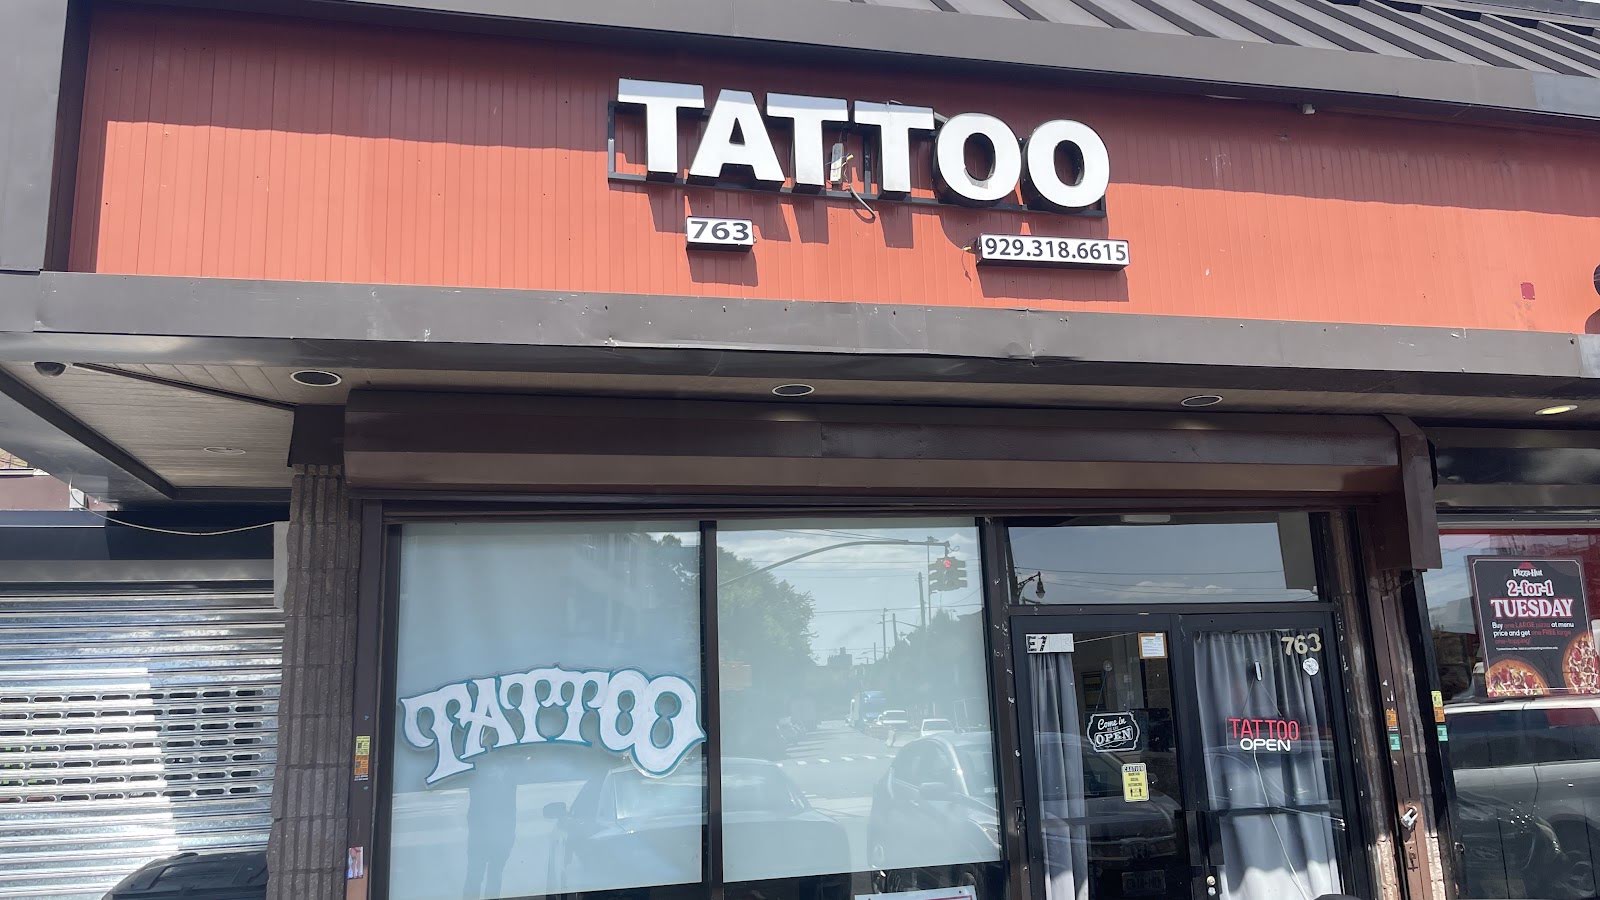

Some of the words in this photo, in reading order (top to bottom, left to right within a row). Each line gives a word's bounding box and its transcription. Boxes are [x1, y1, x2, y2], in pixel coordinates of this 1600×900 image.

[617, 78, 1110, 208] TATTOO
[691, 220, 750, 242] 763
[984, 237, 1128, 263] 929.318.6615
[1507, 580, 1554, 596] 2-for-1
[1490, 599, 1573, 617] TUESDAY
[1492, 622, 1503, 630] Buy
[1493, 630, 1508, 638] price
[1281, 633, 1322, 656] 763
[399, 664, 707, 785] TATTOO
[1098, 718, 1118, 730] Come
[1118, 716, 1127, 725] in
[1228, 718, 1299, 740] TATTOO
[1096, 728, 1131, 745] OPEN
[1240, 738, 1291, 751] OPEN
